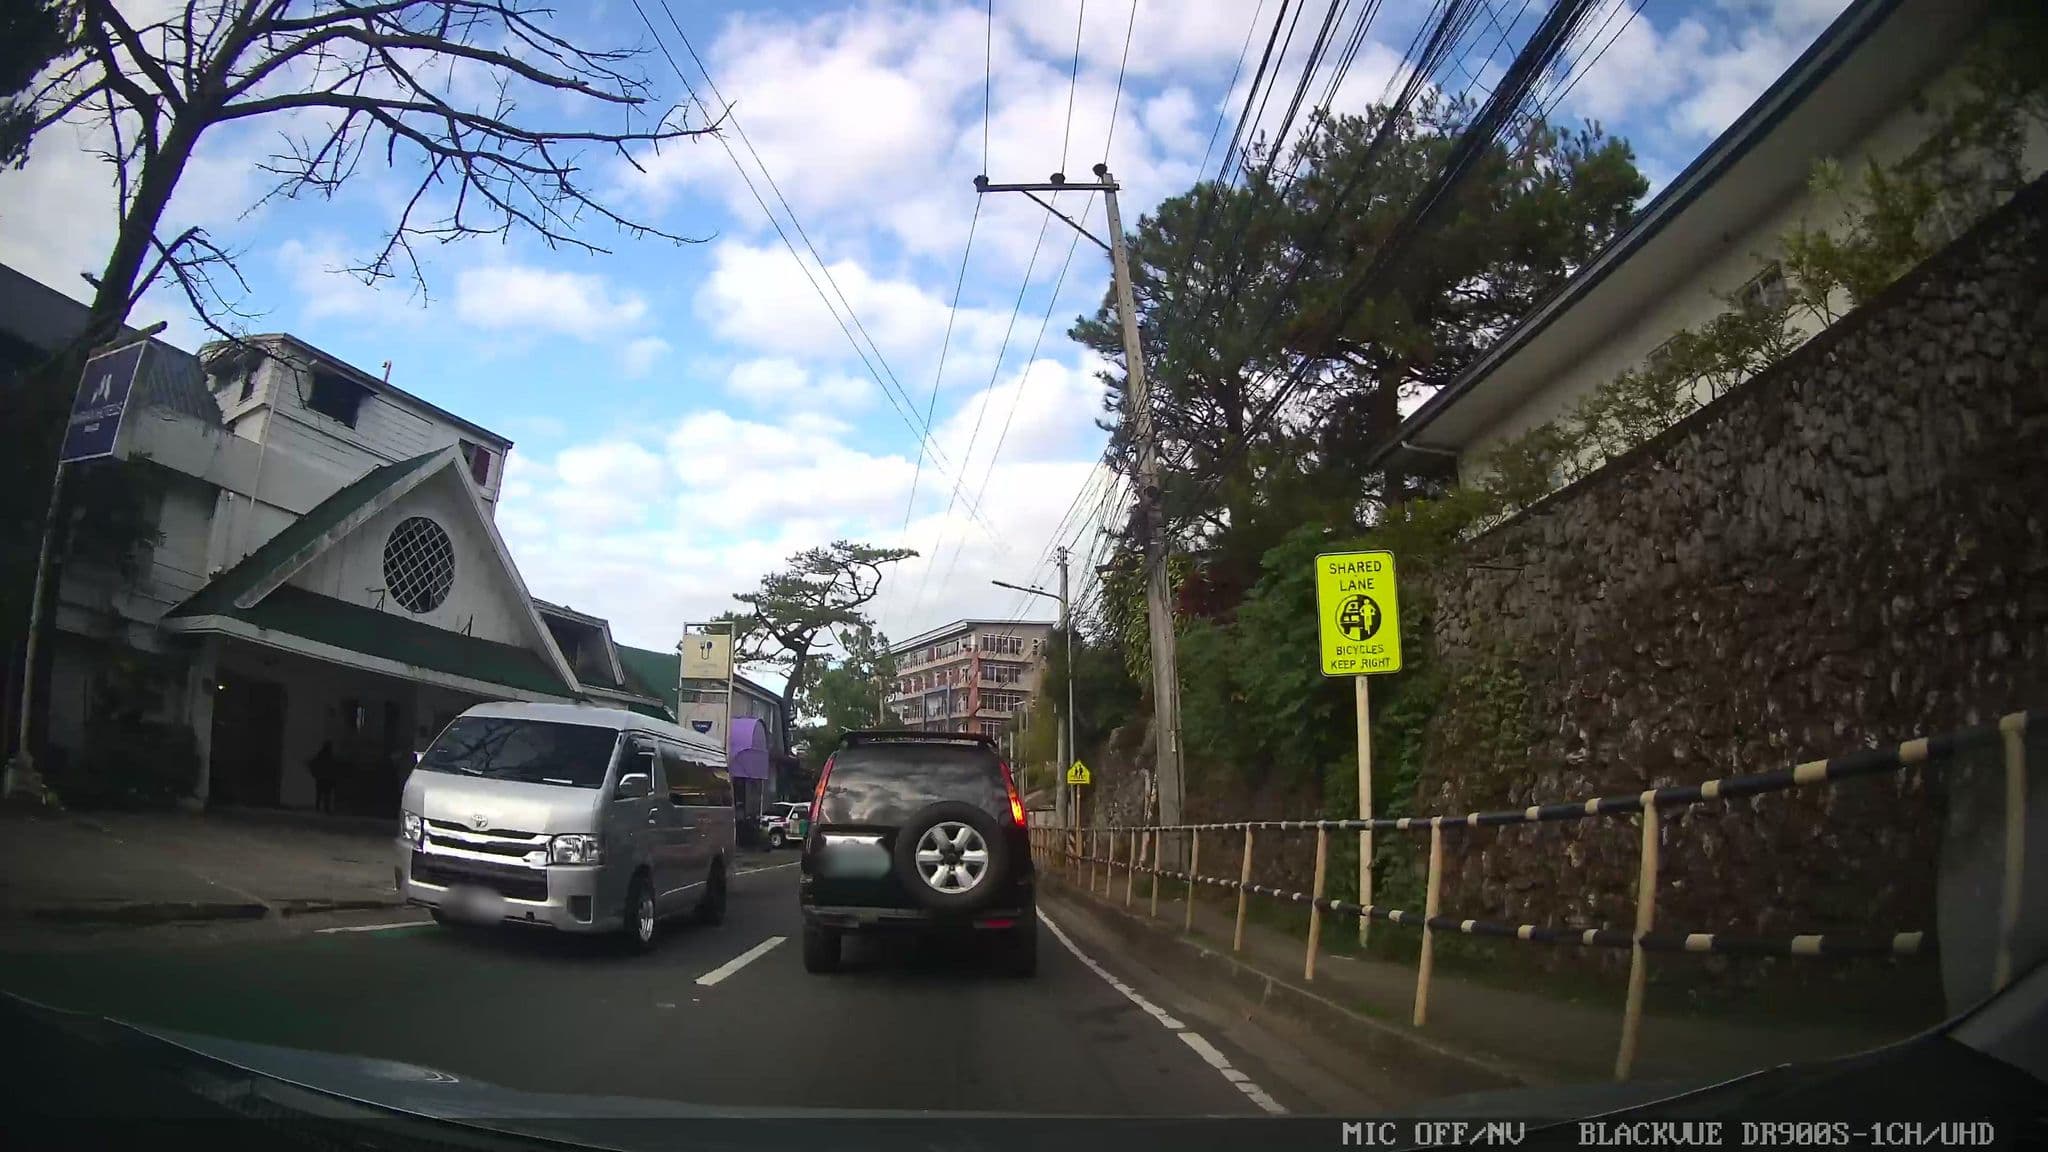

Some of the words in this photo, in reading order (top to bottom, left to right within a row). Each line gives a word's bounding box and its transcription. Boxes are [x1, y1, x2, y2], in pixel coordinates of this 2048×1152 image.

[1329, 560, 1382, 575] SHARED
[1340, 578, 1375, 592] LANE
[1336, 644, 1384, 655] BICYCLES
[1331, 659, 1356, 670] KEEP
[1361, 657, 1391, 669] RIGHT
